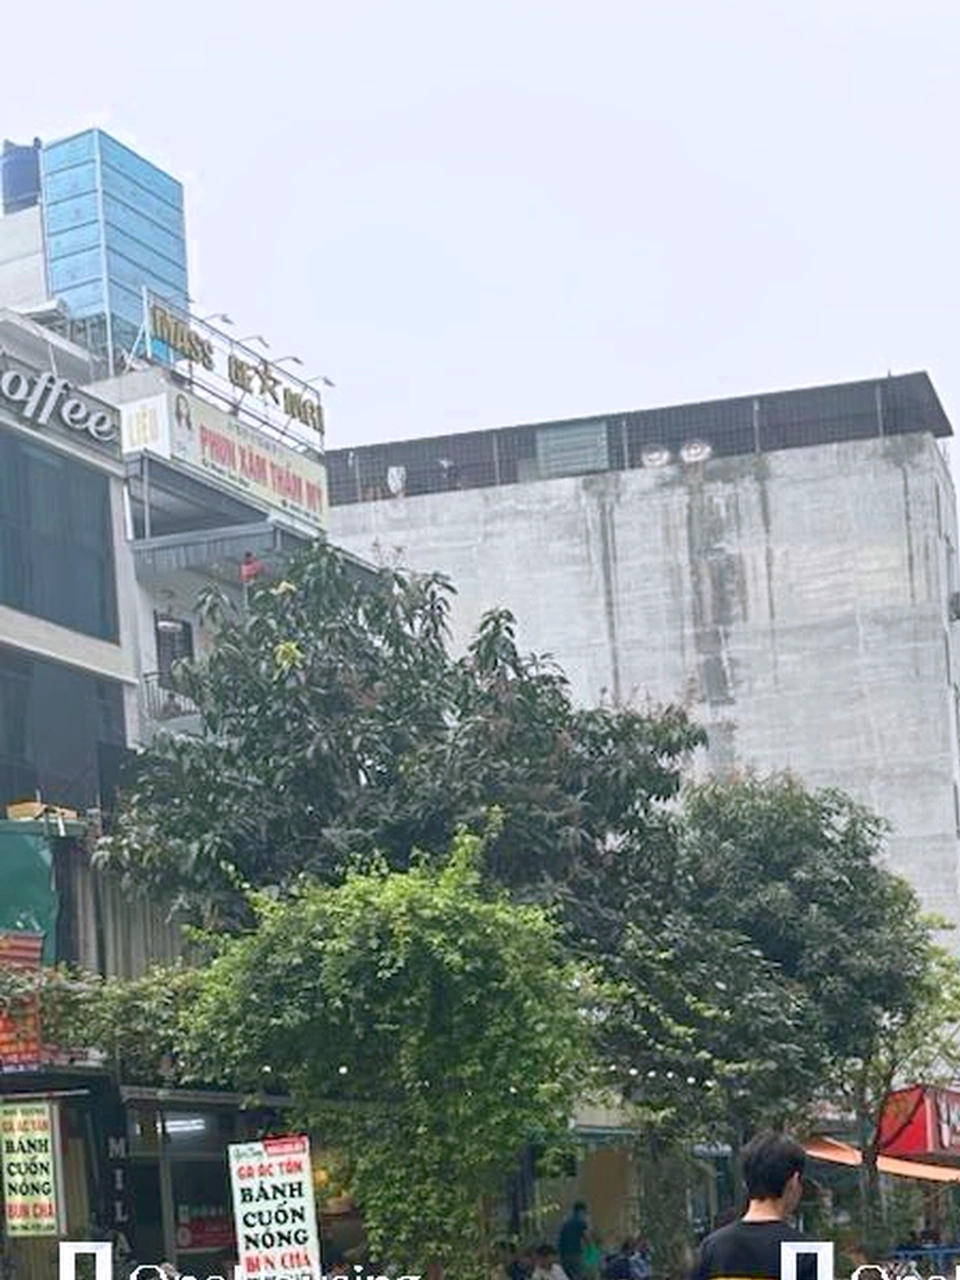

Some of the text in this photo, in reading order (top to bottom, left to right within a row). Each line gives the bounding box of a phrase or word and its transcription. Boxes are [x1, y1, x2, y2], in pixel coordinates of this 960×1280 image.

[240, 1180, 304, 1204] BÁNH
[242, 1200, 306, 1229] CUỐN
[244, 1228, 309, 1251] NÓNG
